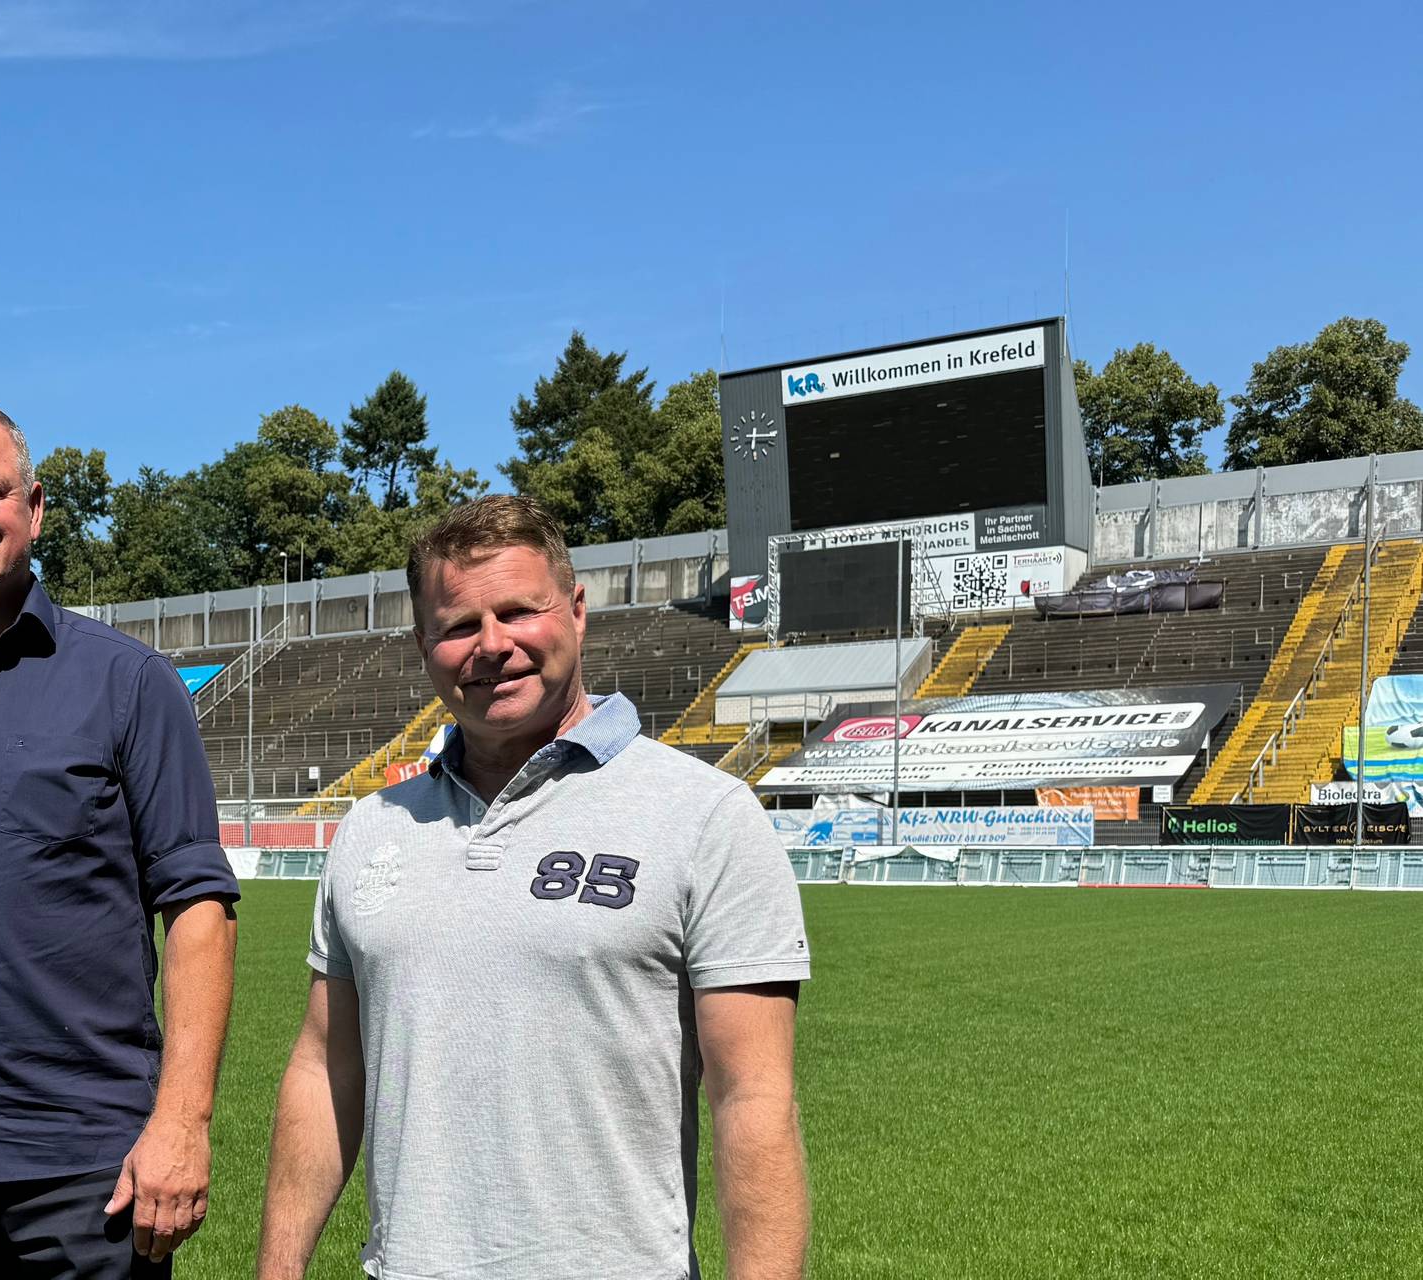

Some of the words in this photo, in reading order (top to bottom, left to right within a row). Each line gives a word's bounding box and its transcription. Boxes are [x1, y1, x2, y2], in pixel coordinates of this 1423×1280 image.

[832, 360, 941, 388] Willkommen
[947, 354, 963, 370] in
[970, 340, 1035, 366] Krefeld
[985, 517, 997, 526] Ihr
[999, 514, 1034, 525] Partner
[987, 527, 995, 535] in
[998, 524, 1032, 534] Sachen
[980, 531, 1040, 545] Metallschrott
[919, 712, 1172, 733] KANALSERVICE
[1318, 788, 1382, 801] Biolectra
[1183, 818, 1237, 833] Helios
[530, 851, 640, 909] 85
